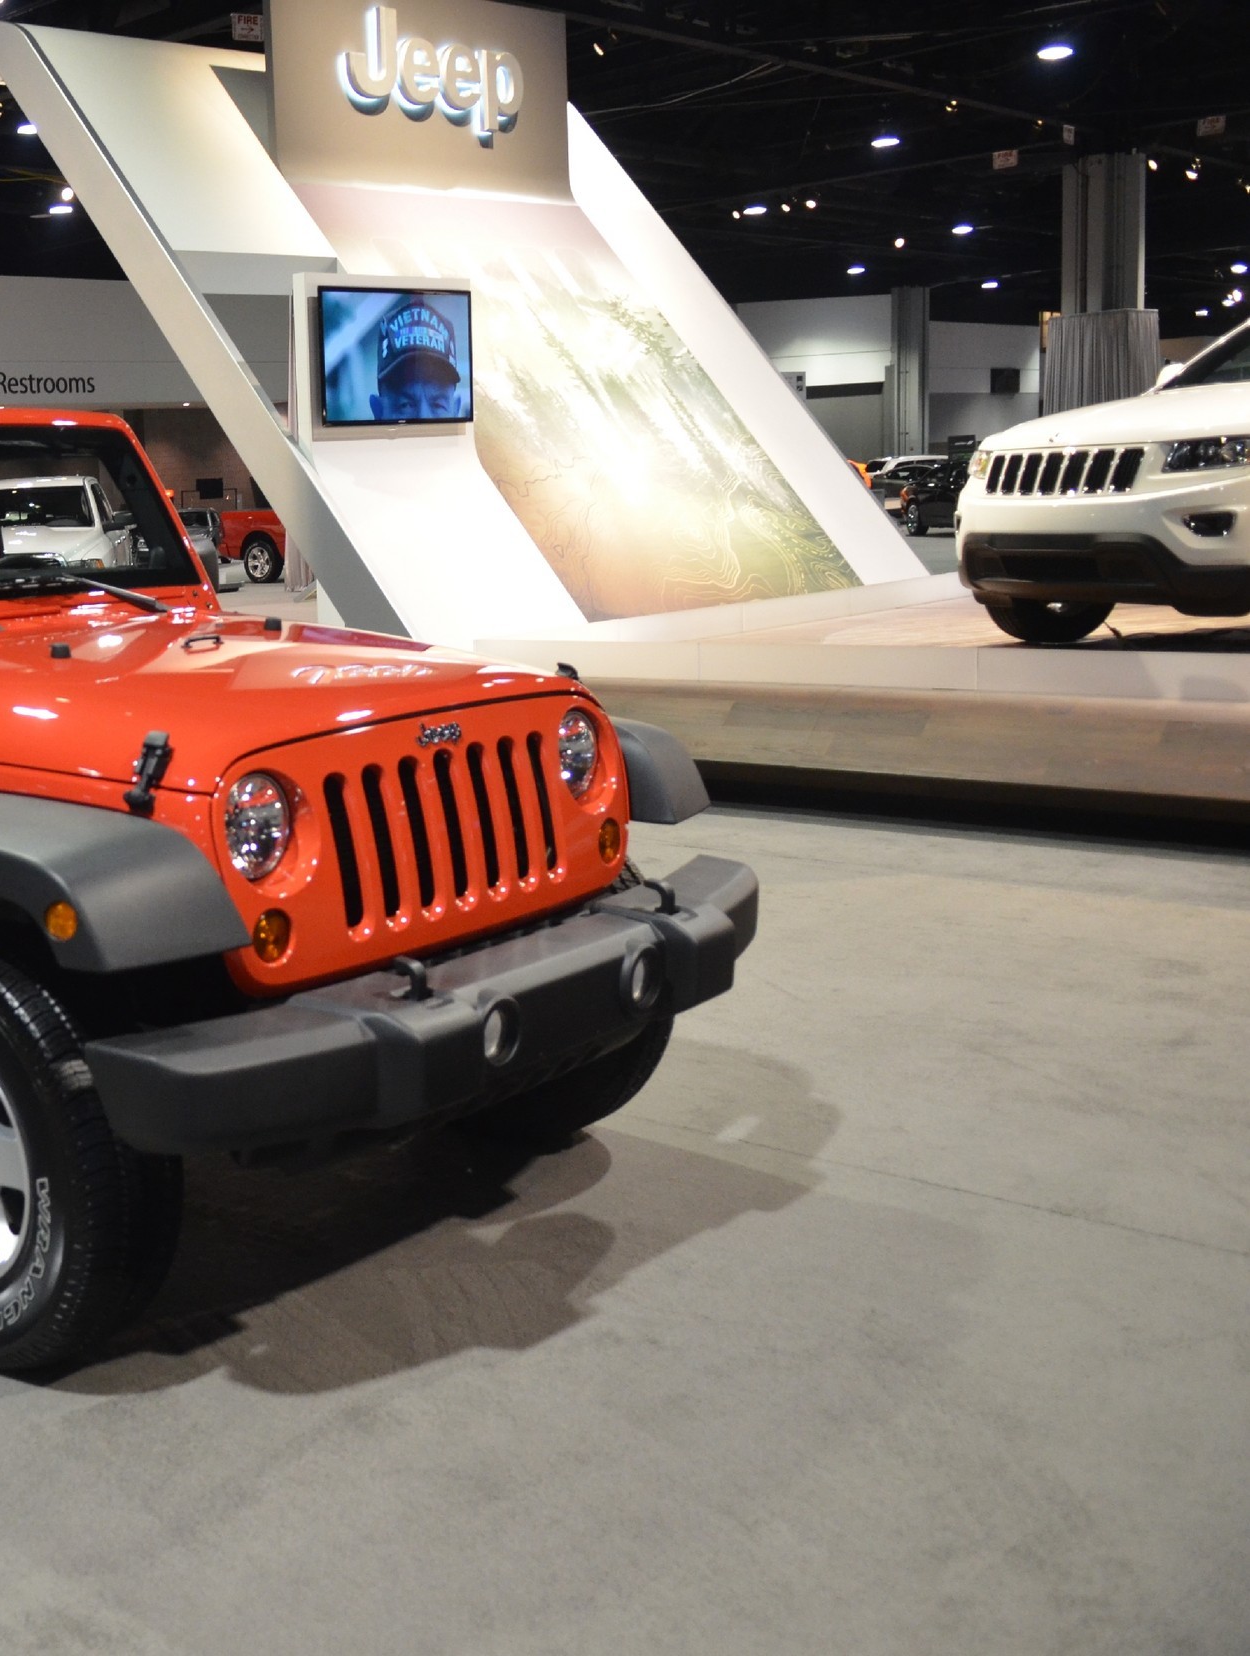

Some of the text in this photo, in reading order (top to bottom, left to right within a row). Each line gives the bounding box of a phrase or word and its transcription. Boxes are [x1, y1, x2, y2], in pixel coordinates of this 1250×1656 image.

[237, 15, 258, 25] FIRE
[342, 6, 524, 137] Jeep
[390, 307, 449, 339] VIETNAM
[394, 335, 445, 353] VETERAN
[415, 721, 462, 747] Jeep
